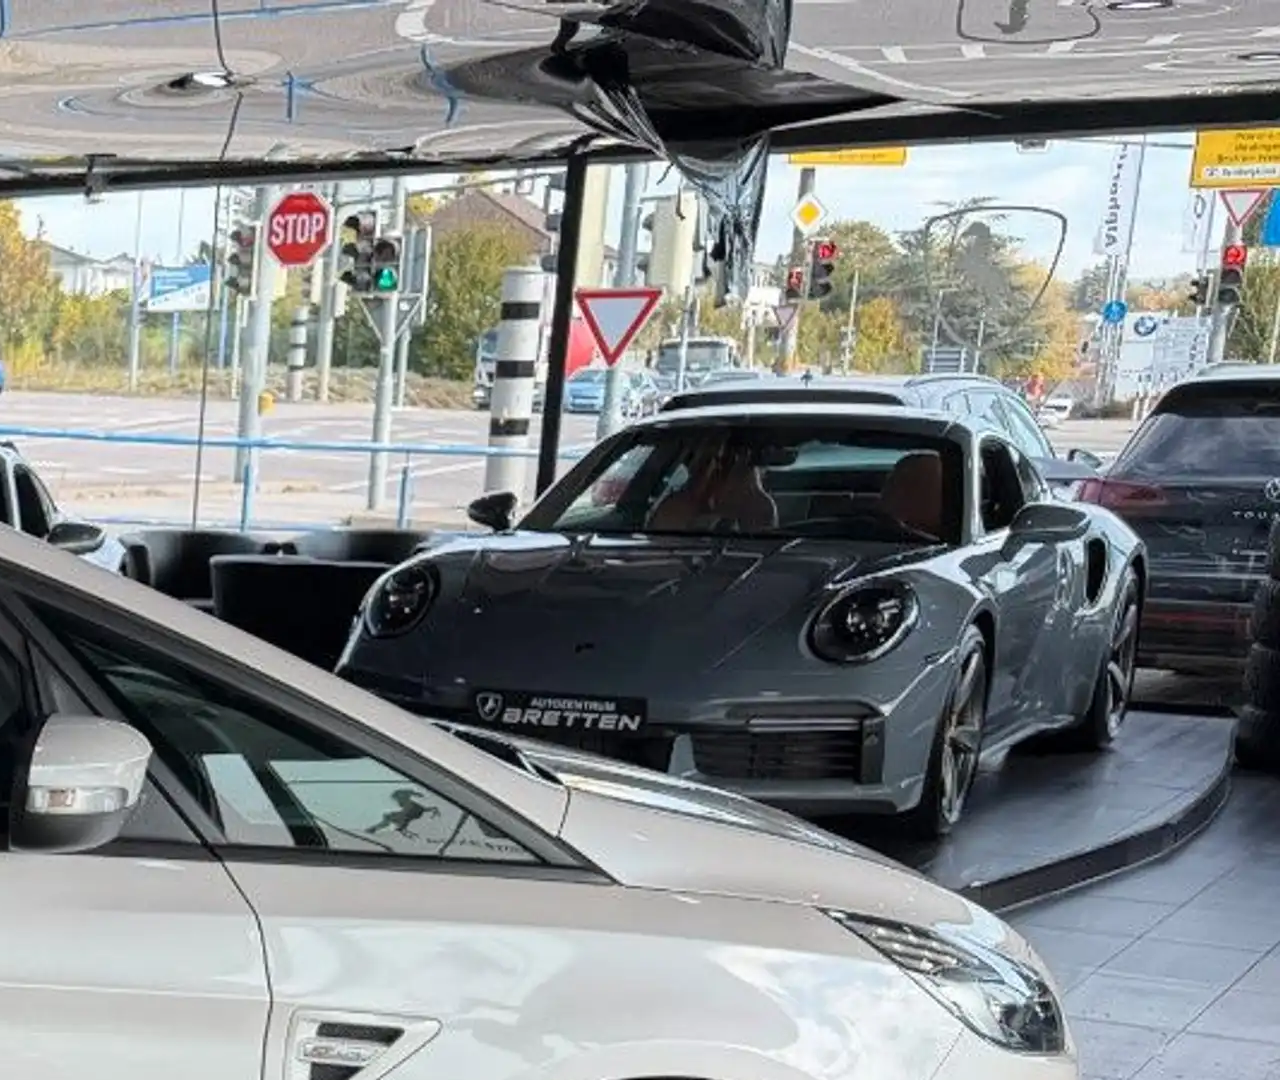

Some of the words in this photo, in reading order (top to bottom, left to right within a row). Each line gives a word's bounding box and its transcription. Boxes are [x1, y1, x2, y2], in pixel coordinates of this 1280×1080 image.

[271, 211, 326, 246] STOP
[531, 698, 617, 711] AUTOZENTRUM
[502, 707, 642, 731] BRETTEN
